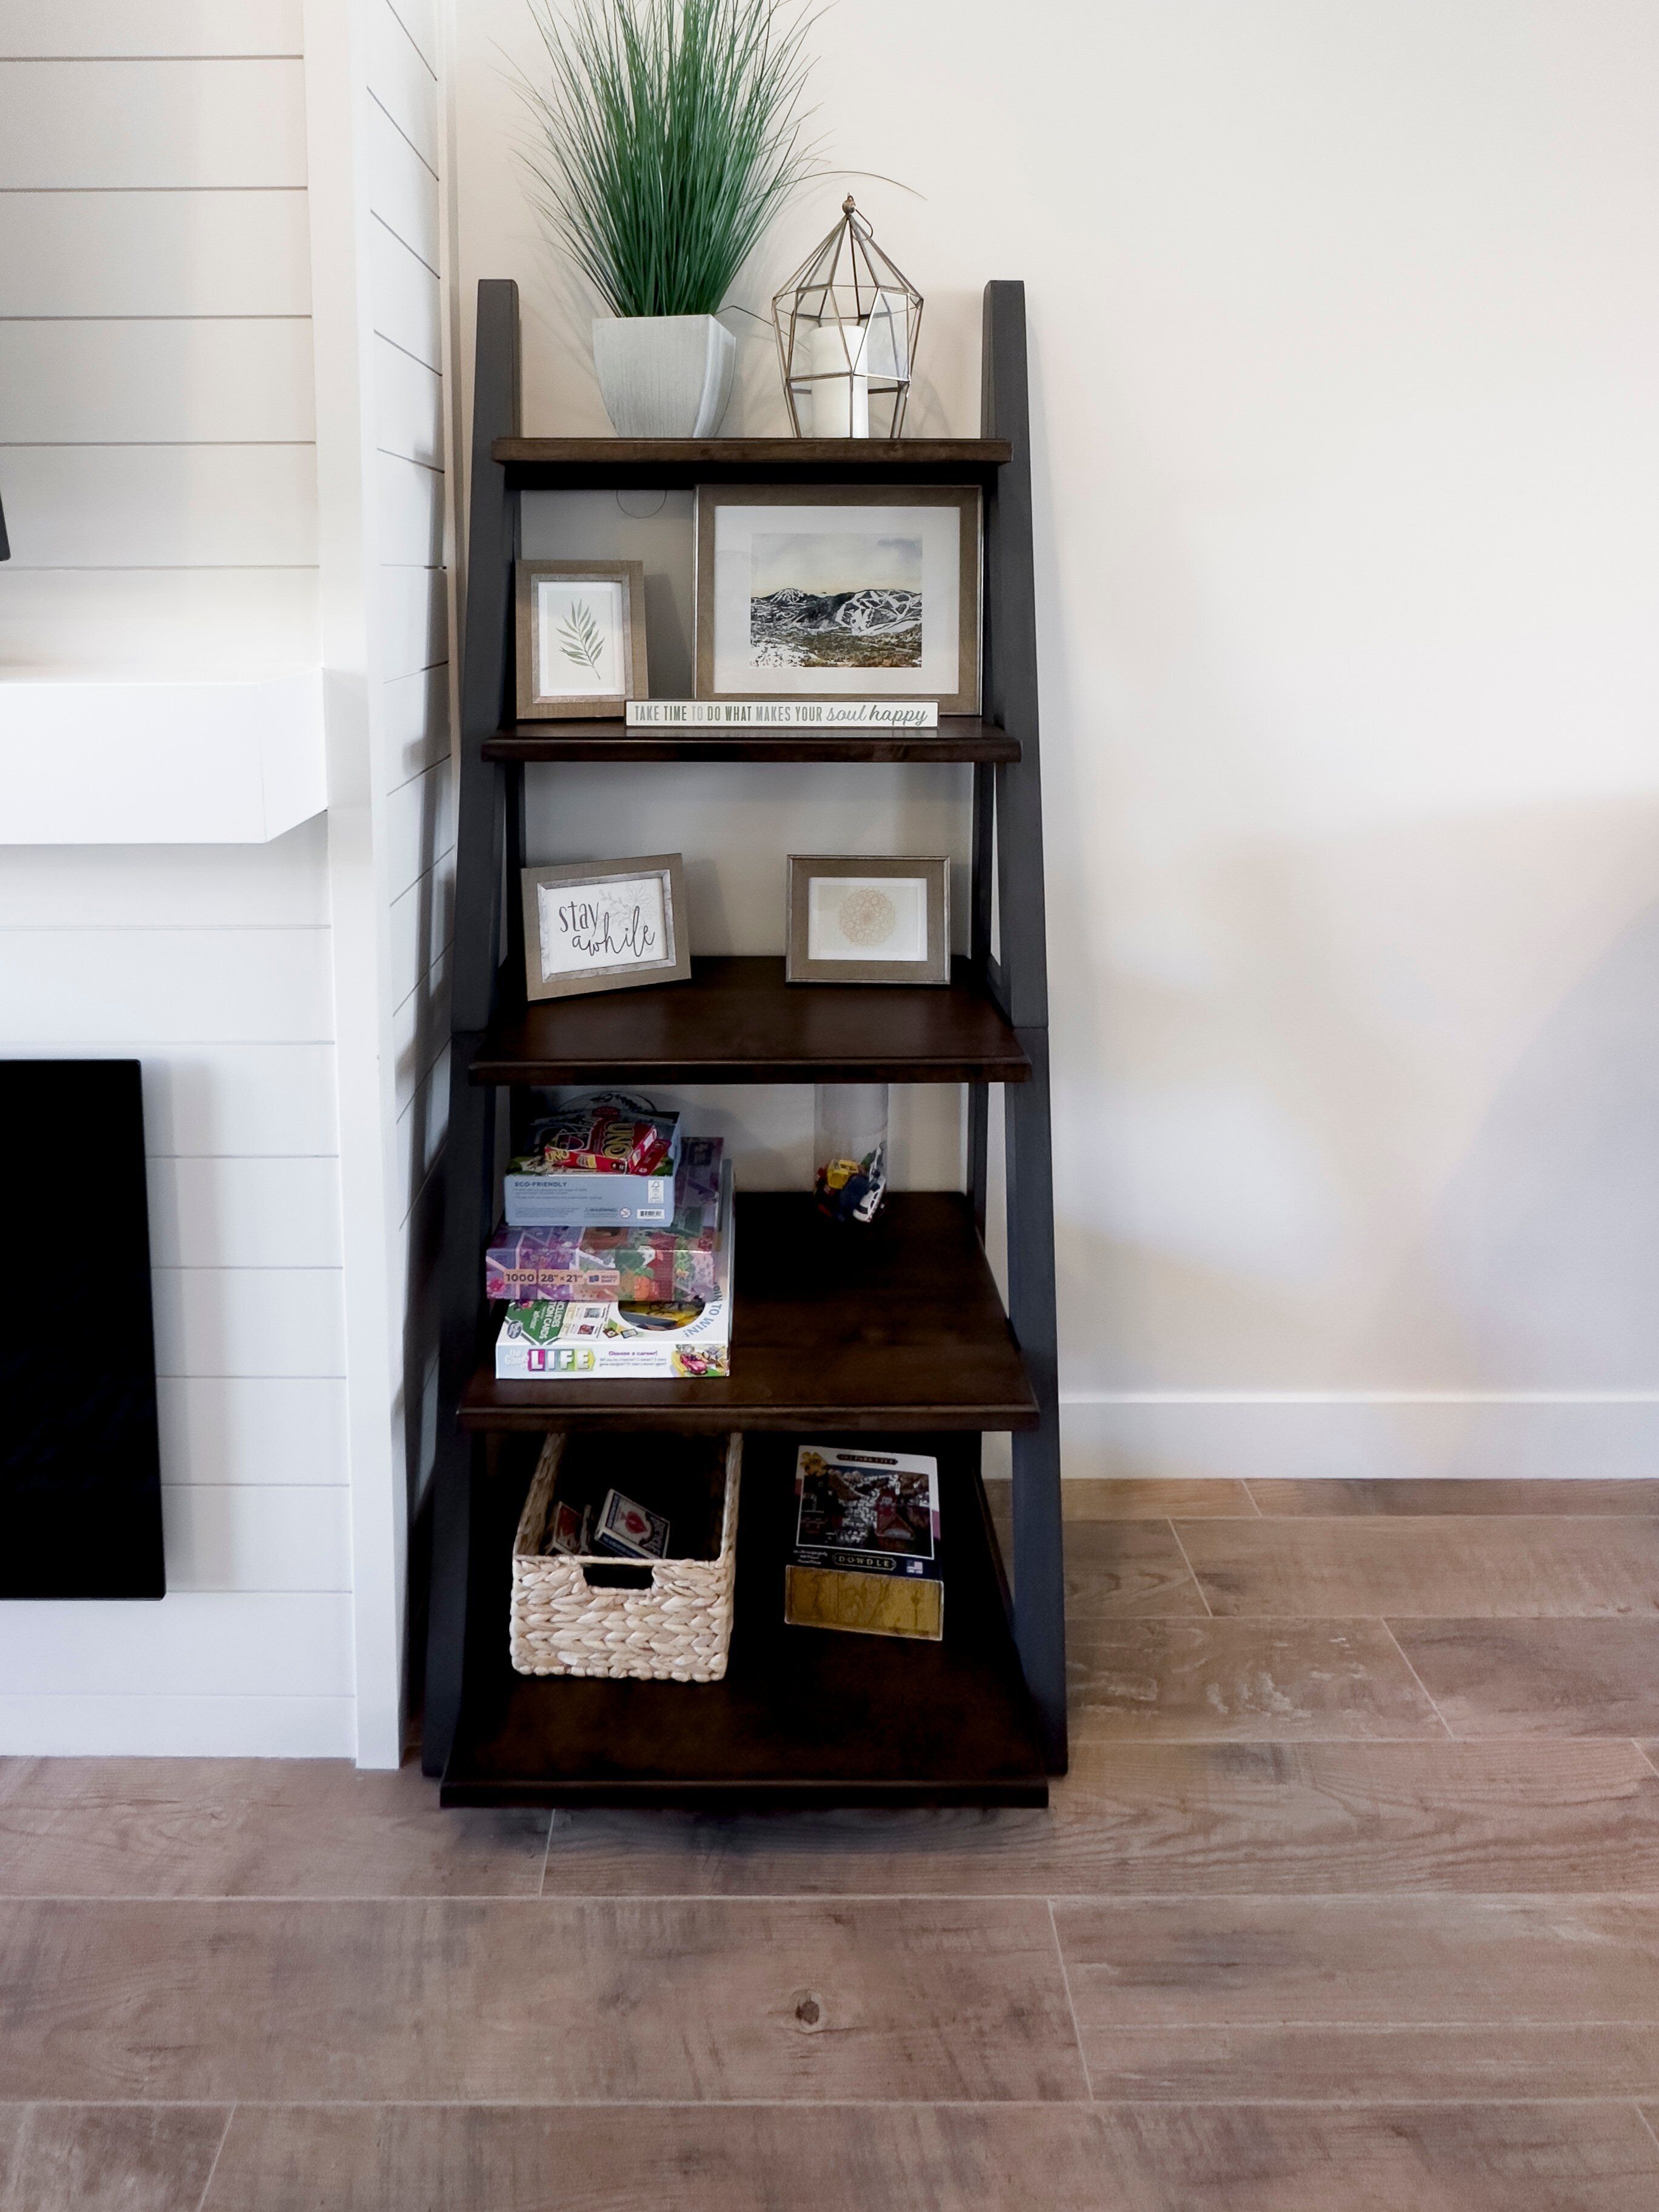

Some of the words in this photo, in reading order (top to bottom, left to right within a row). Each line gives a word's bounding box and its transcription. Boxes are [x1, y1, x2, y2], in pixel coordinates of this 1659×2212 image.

[635, 705, 659, 722] TAKE
[664, 705, 687, 722] TIME
[692, 705, 704, 722] TO
[707, 705, 721, 722] DO
[725, 705, 752, 722] WHAT
[755, 705, 791, 722] MAKES
[795, 705, 823, 722] YOUR
[826, 704, 867, 722] soul
[868, 704, 929, 726] happy
[558, 900, 599, 938] stay
[572, 905, 655, 957] awhile
[601, 1121, 635, 1158] UNO
[546, 1149, 570, 1161] UNO
[506, 1273, 535, 1282] 1000
[709, 1303, 723, 1316] TO
[683, 1317, 715, 1338] WIN!
[531, 1350, 590, 1370] LIFE
[838, 1555, 890, 1568] DOWDLE
